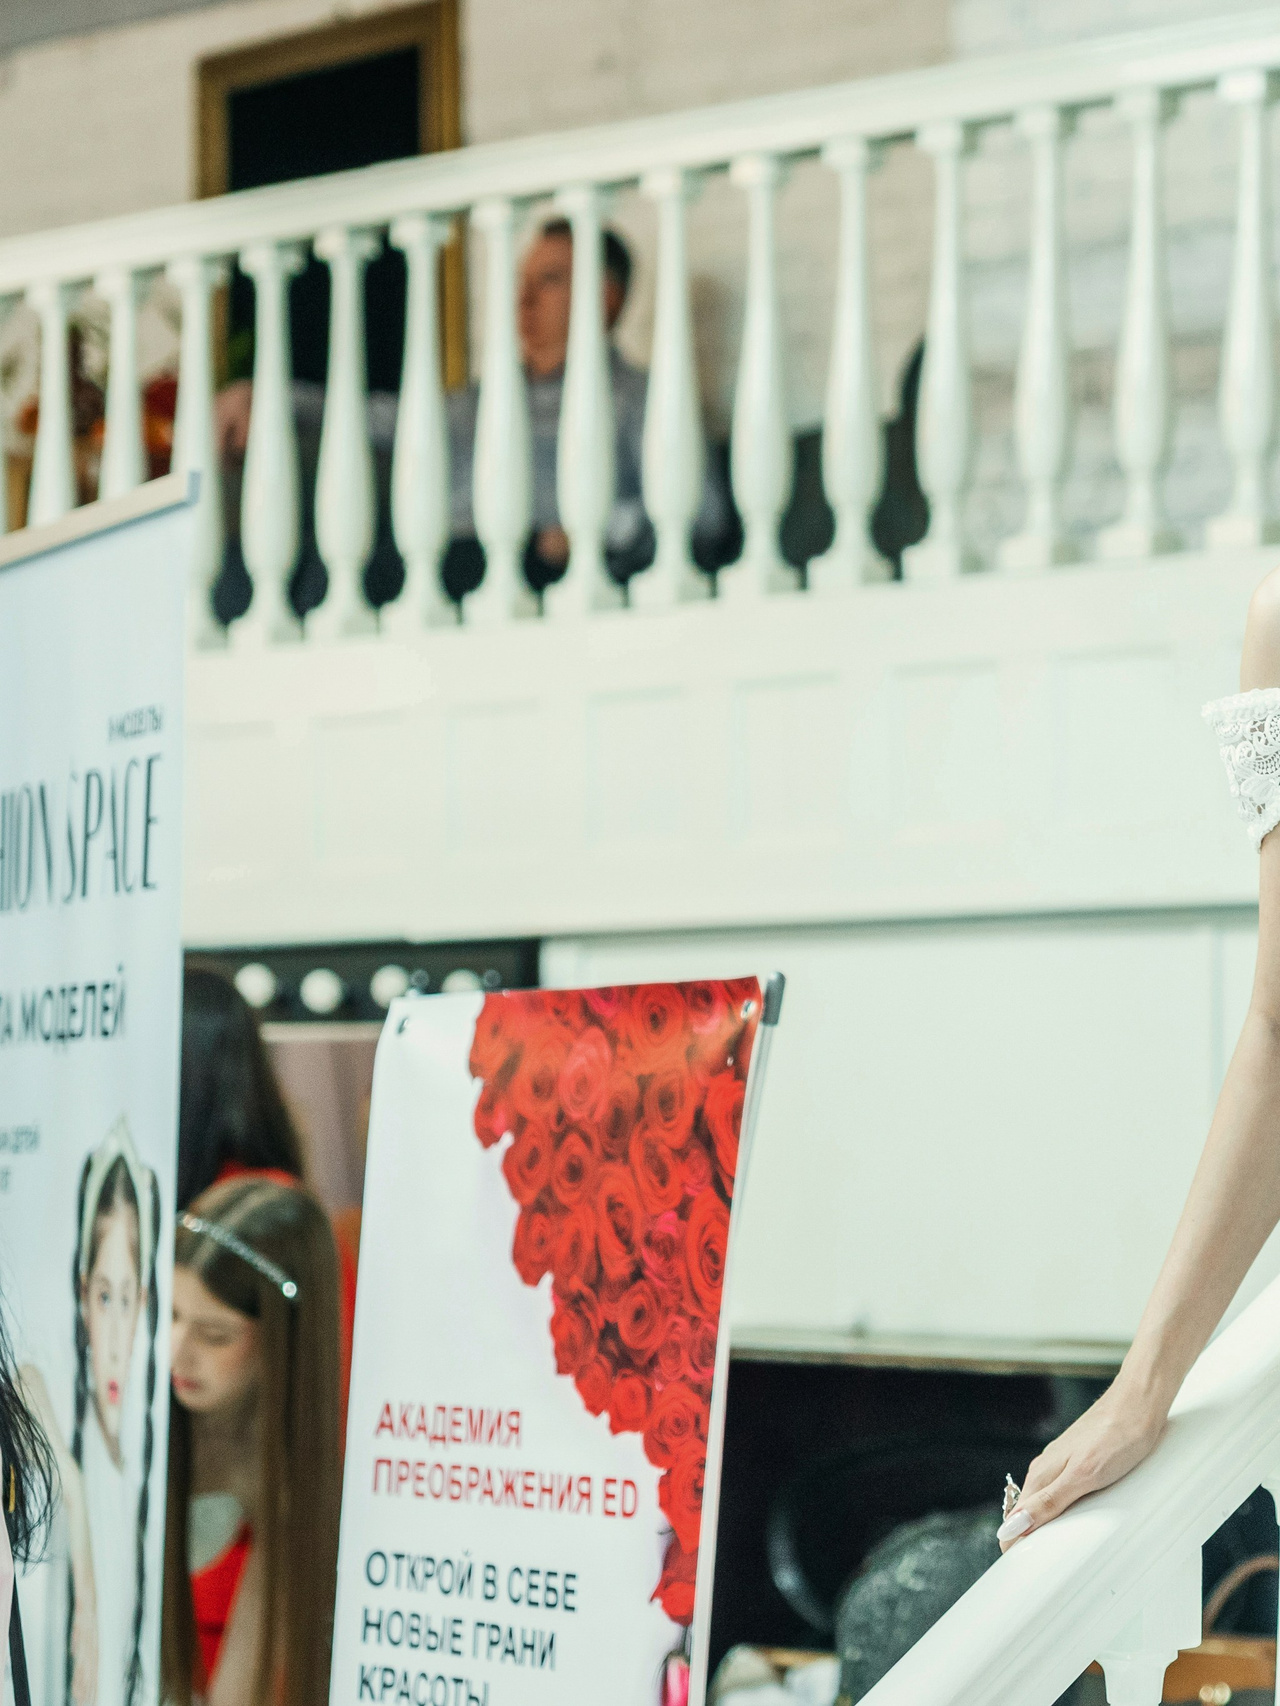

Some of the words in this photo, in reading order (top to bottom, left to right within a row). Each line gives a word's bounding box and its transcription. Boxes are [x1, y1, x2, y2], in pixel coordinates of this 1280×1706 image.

[62, 752, 162, 904] SPACE
[19, 962, 127, 1053] МОДЕЛЕЙ
[375, 1402, 521, 1446] АКАДЕМИЯ
[372, 1458, 592, 1515] ПРЕОБРАЖЕНИЯ
[603, 1478, 640, 1518] ED
[365, 1550, 474, 1597] ОТКРОЙ
[482, 1563, 499, 1601] В
[507, 1567, 579, 1613] СЕБЕ
[361, 1607, 463, 1656] НОВЫЕ
[472, 1622, 557, 1669] ГРАНИ
[359, 1665, 489, 1706] КРАСОТЫ
